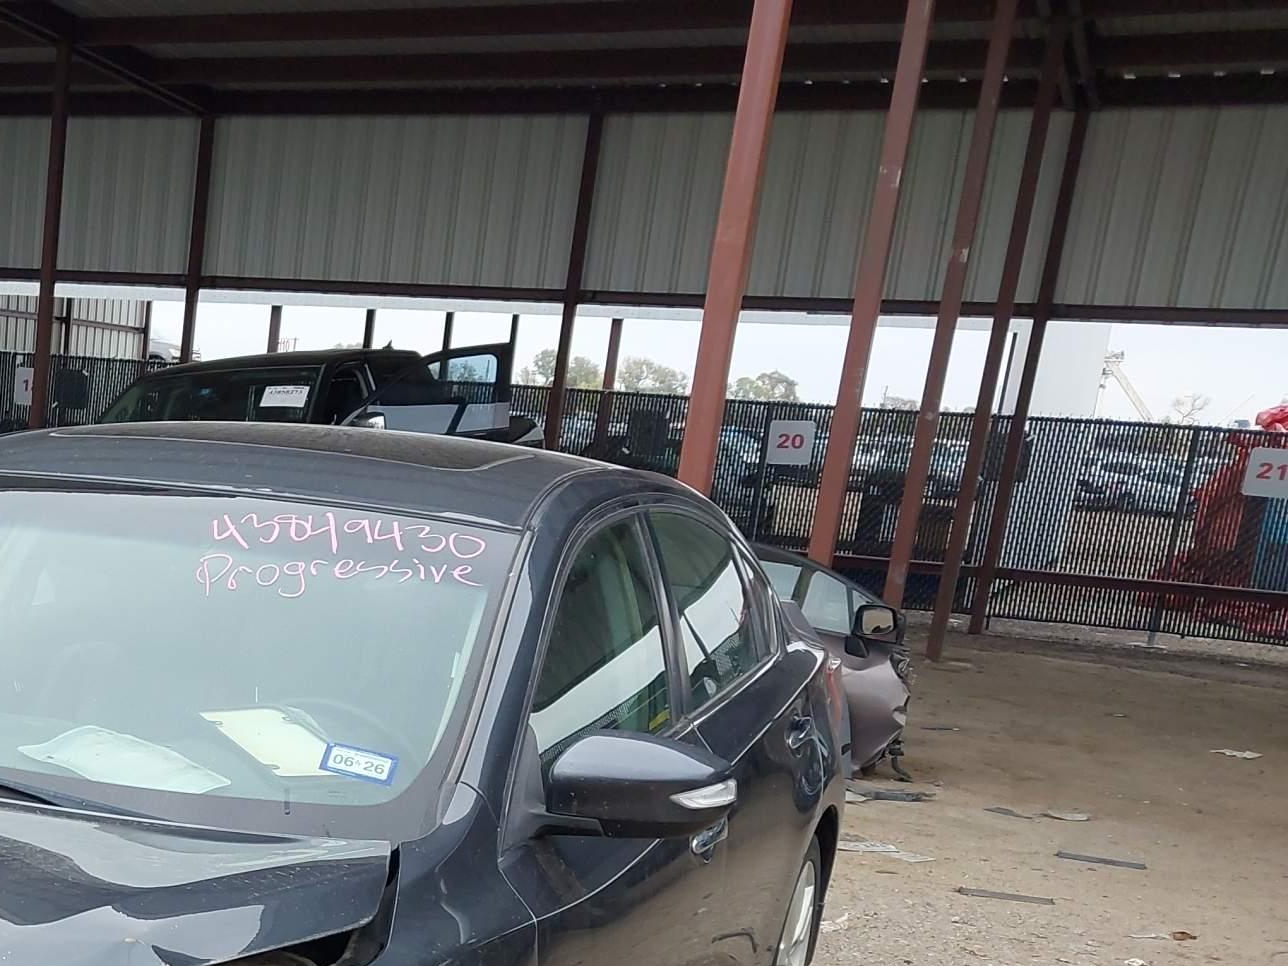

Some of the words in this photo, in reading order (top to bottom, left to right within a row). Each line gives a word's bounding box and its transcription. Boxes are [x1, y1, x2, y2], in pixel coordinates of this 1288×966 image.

[776, 433, 805, 449] 20
[1255, 462, 1288, 481] 21
[211, 511, 487, 558] 43849430
[196, 553, 485, 597] Progressive
